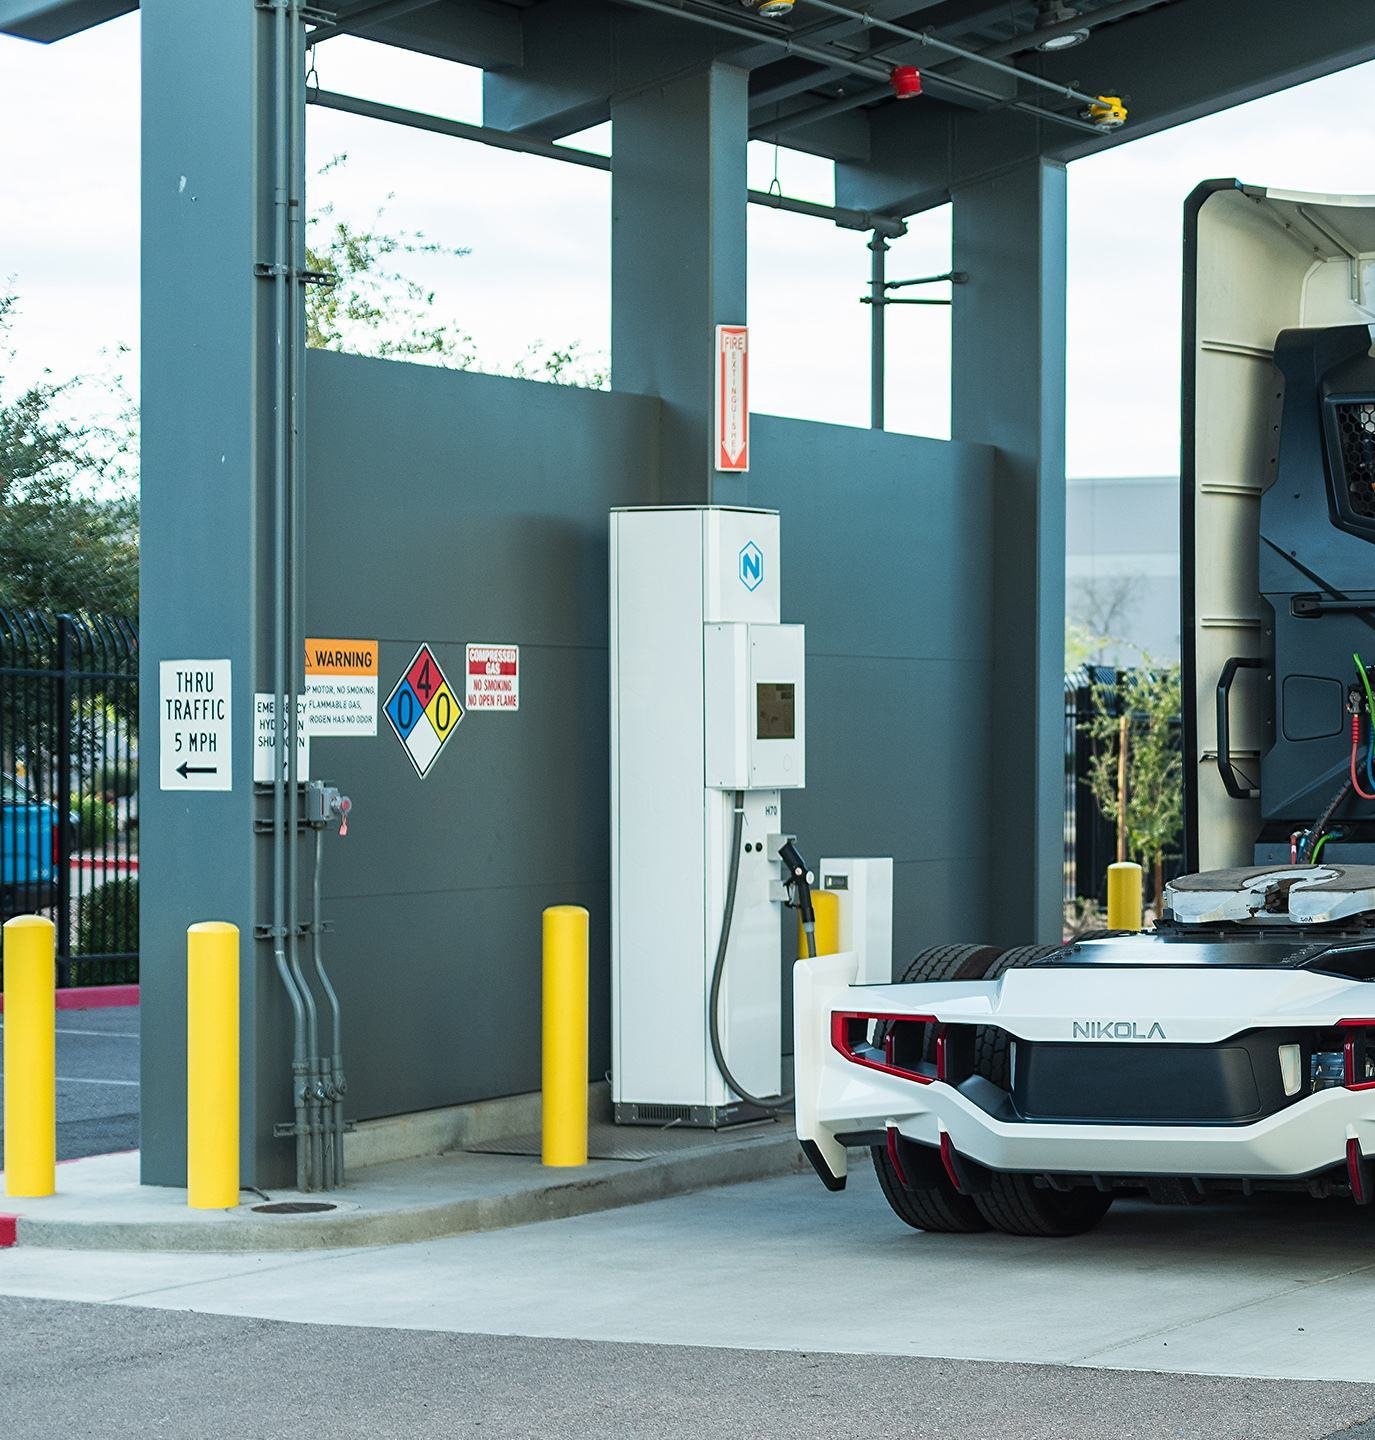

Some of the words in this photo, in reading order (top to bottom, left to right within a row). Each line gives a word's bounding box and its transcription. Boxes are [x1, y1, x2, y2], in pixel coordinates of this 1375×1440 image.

[725, 336, 743, 350] FIRE
[742, 553, 760, 580] N
[315, 650, 373, 668] WARNING
[469, 649, 516, 663] COMPRESSED
[485, 662, 501, 675] GAS
[176, 671, 214, 692] THRU
[417, 659, 431, 699] 4
[473, 679, 482, 691] NO
[484, 679, 512, 691] SMOKING
[336, 686, 346, 694] NO
[308, 700, 347, 709] FLAMMABLE
[468, 694, 477, 706] NO
[479, 694, 495, 706] OPEN
[497, 694, 517, 707] FLAME
[166, 699, 225, 720] TRAFFIC
[398, 690, 413, 729] 0
[436, 692, 450, 731] 0
[332, 715, 346, 724] HAS
[346, 716, 355, 724] NO
[356, 716, 373, 724] ODOR
[175, 733, 182, 752] 5
[189, 732, 217, 752] MPH
[765, 805, 778, 816] H70
[1072, 1021, 1167, 1040] NIKOLA
